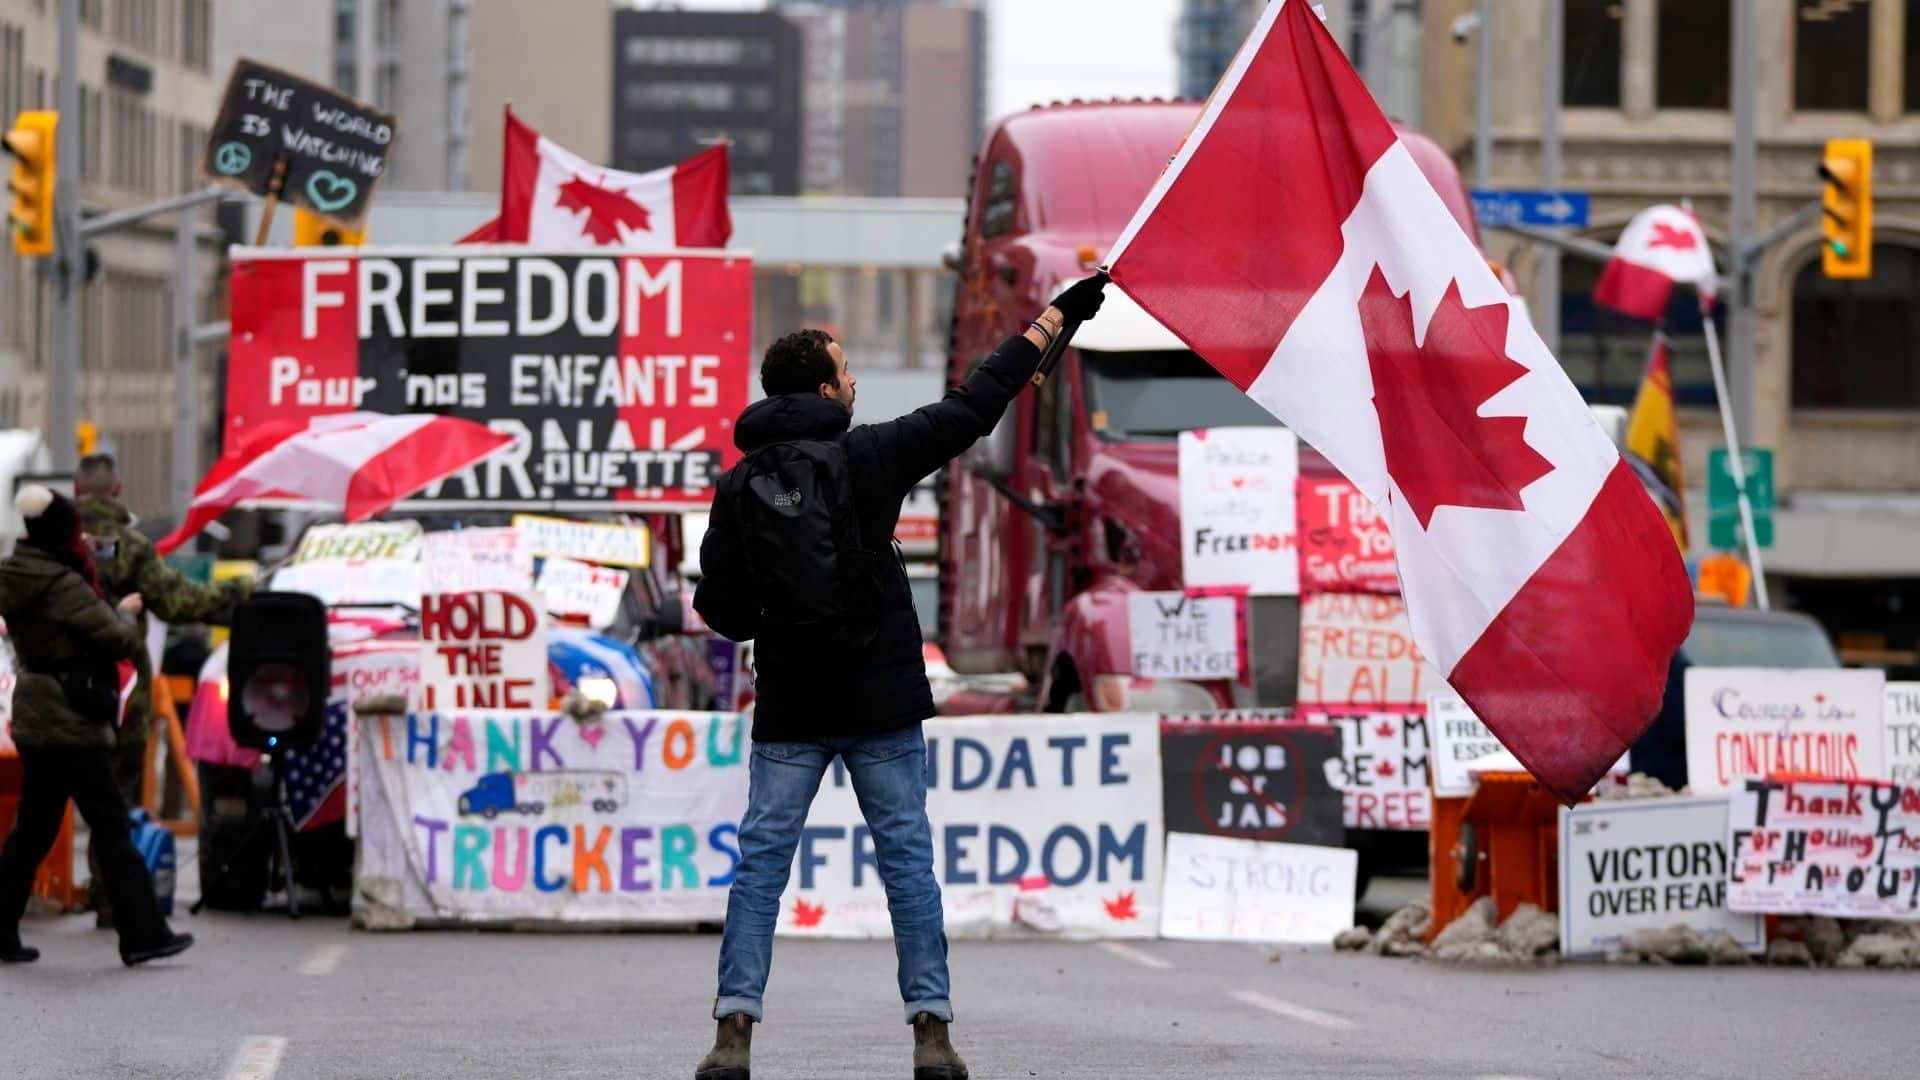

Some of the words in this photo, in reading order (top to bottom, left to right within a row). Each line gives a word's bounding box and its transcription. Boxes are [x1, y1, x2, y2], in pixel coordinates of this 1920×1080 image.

[245, 78, 295, 111] THE
[312, 101, 392, 145] WORLD
[240, 113, 271, 137] IS
[281, 124, 384, 177] WATCHING
[302, 257, 682, 340] FREEDOM
[269, 356, 376, 406] Pour
[510, 355, 721, 407] ENFANTS
[421, 590, 537, 641] HOLD
[1155, 596, 1208, 619] WE
[1155, 621, 1209, 643] THE
[437, 645, 504, 676] THE
[622, 716, 744, 772] YOU
[1217, 743, 1286, 771] JOB
[1716, 731, 1859, 787] CONTAGIOUS
[1217, 801, 1287, 827] JAB
[1745, 780, 1862, 828] Thank
[1871, 781, 1920, 837] Yo
[414, 815, 741, 892] TRUCKERS
[800, 821, 1147, 889] FREDOM
[1189, 853, 1332, 897] STRONG
[1587, 841, 1727, 884] VICTORY
[1588, 886, 1657, 919] OVER
